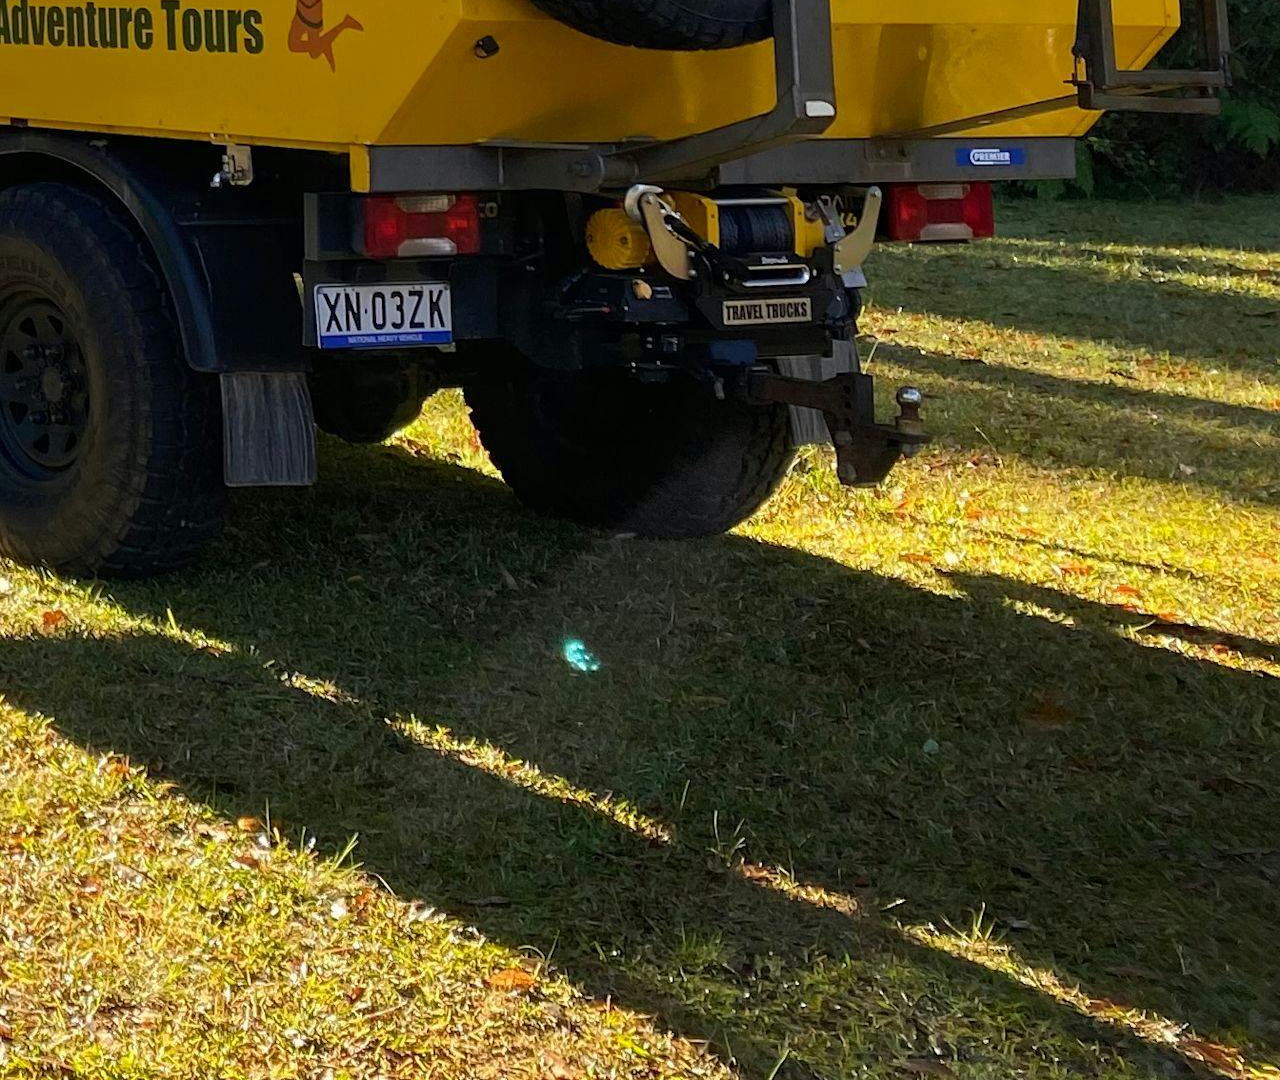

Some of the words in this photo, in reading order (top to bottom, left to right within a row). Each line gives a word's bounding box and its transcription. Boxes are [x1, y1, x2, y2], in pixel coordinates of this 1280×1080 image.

[160, 0, 264, 54] Tours
[973, 151, 1011, 162] PREMIER
[725, 304, 763, 320] TRAVEL
[765, 302, 807, 319] TRUCKS
[347, 336, 376, 344] NATIONAL
